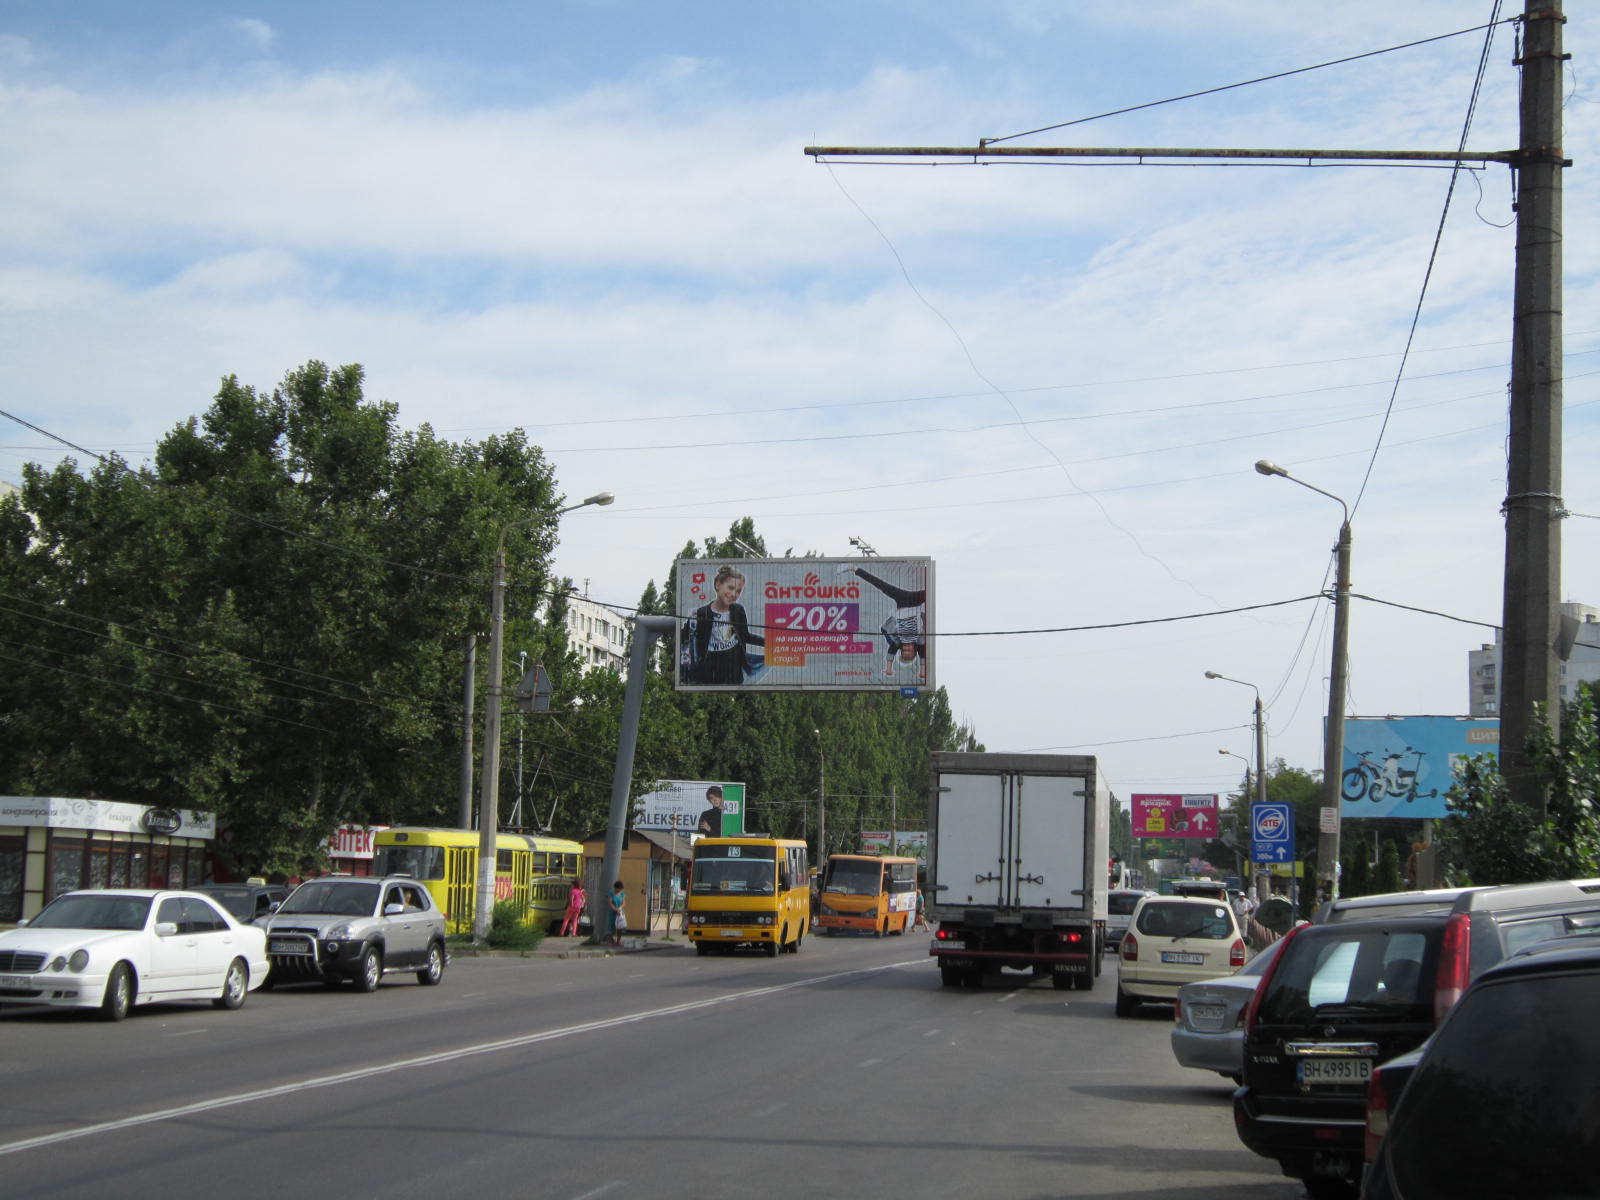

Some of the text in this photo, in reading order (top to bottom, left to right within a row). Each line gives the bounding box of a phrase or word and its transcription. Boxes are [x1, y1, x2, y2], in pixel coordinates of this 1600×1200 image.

[775, 606, 848, 631] -20%
[788, 636, 807, 644] нову
[639, 813, 698, 826] ALEKSEEV
[1261, 819, 1281, 828] АТБ
